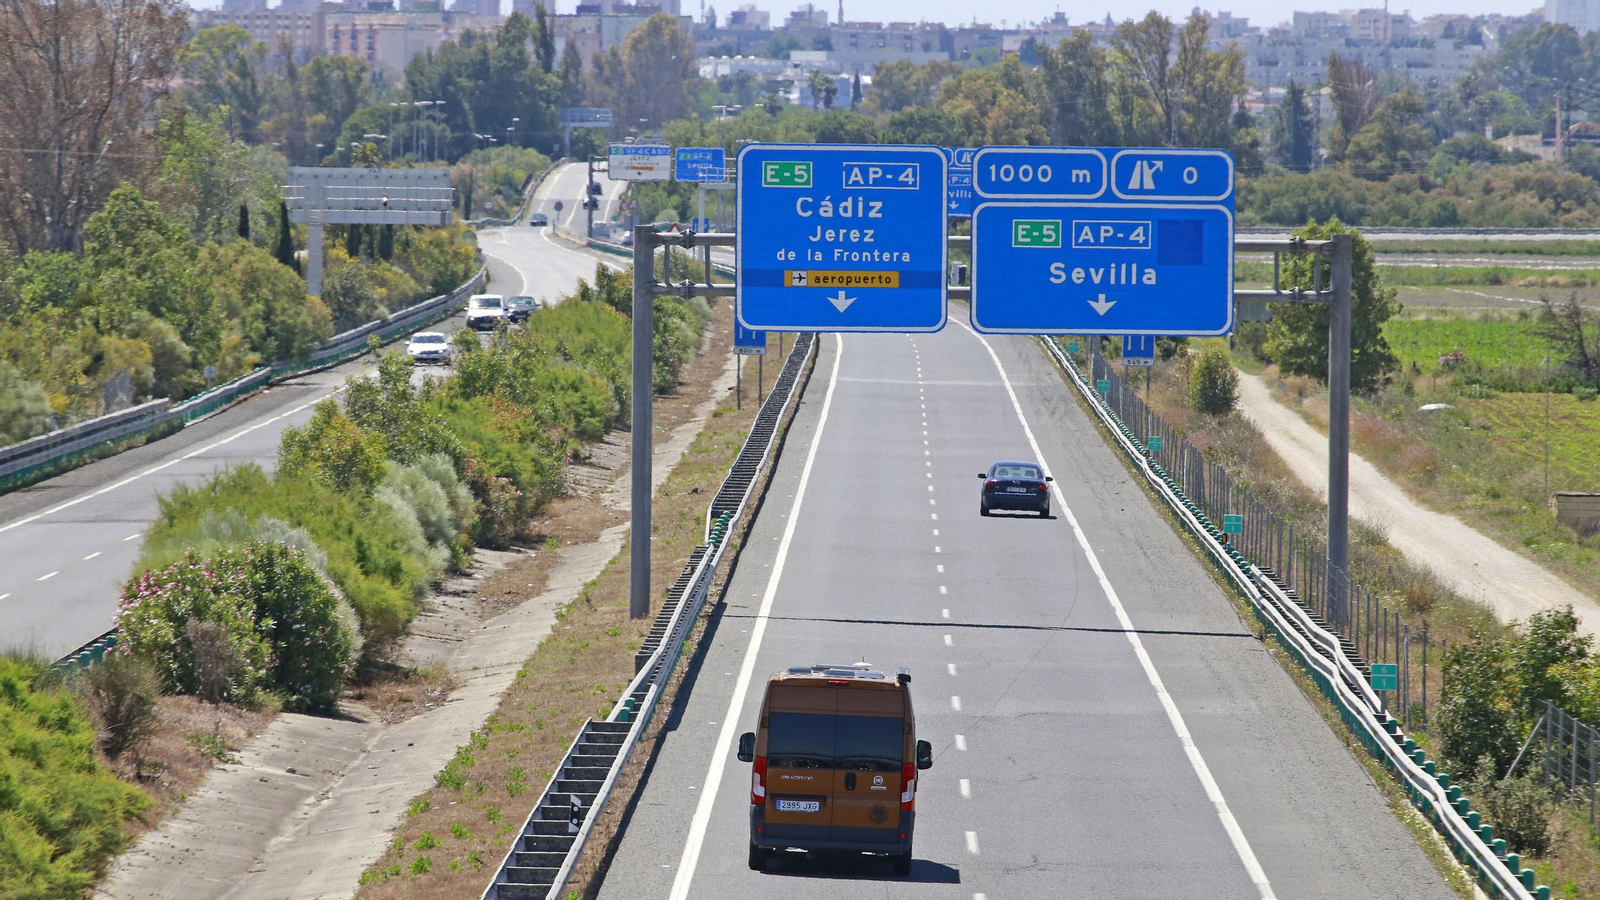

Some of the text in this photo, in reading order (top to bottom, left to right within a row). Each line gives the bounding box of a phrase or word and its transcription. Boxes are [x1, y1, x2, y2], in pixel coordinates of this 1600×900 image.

[766, 164, 915, 185] E-5 AP-4
[948, 176, 970, 184] P-4
[989, 164, 1091, 183] 1000 m
[948, 189, 971, 198] villa
[796, 196, 883, 219] Cádiz
[808, 225, 875, 242] Jerez
[1017, 224, 1146, 244] E-5 AP-4
[776, 248, 911, 262] de la Frontera
[814, 273, 892, 286] aeropuerto
[1049, 262, 1157, 285] Sevilla
[1381, 666, 1387, 674] 6
[1382, 678, 1386, 687] 1
[781, 801, 801, 810] 2995
[803, 802, 818, 810] JXG
